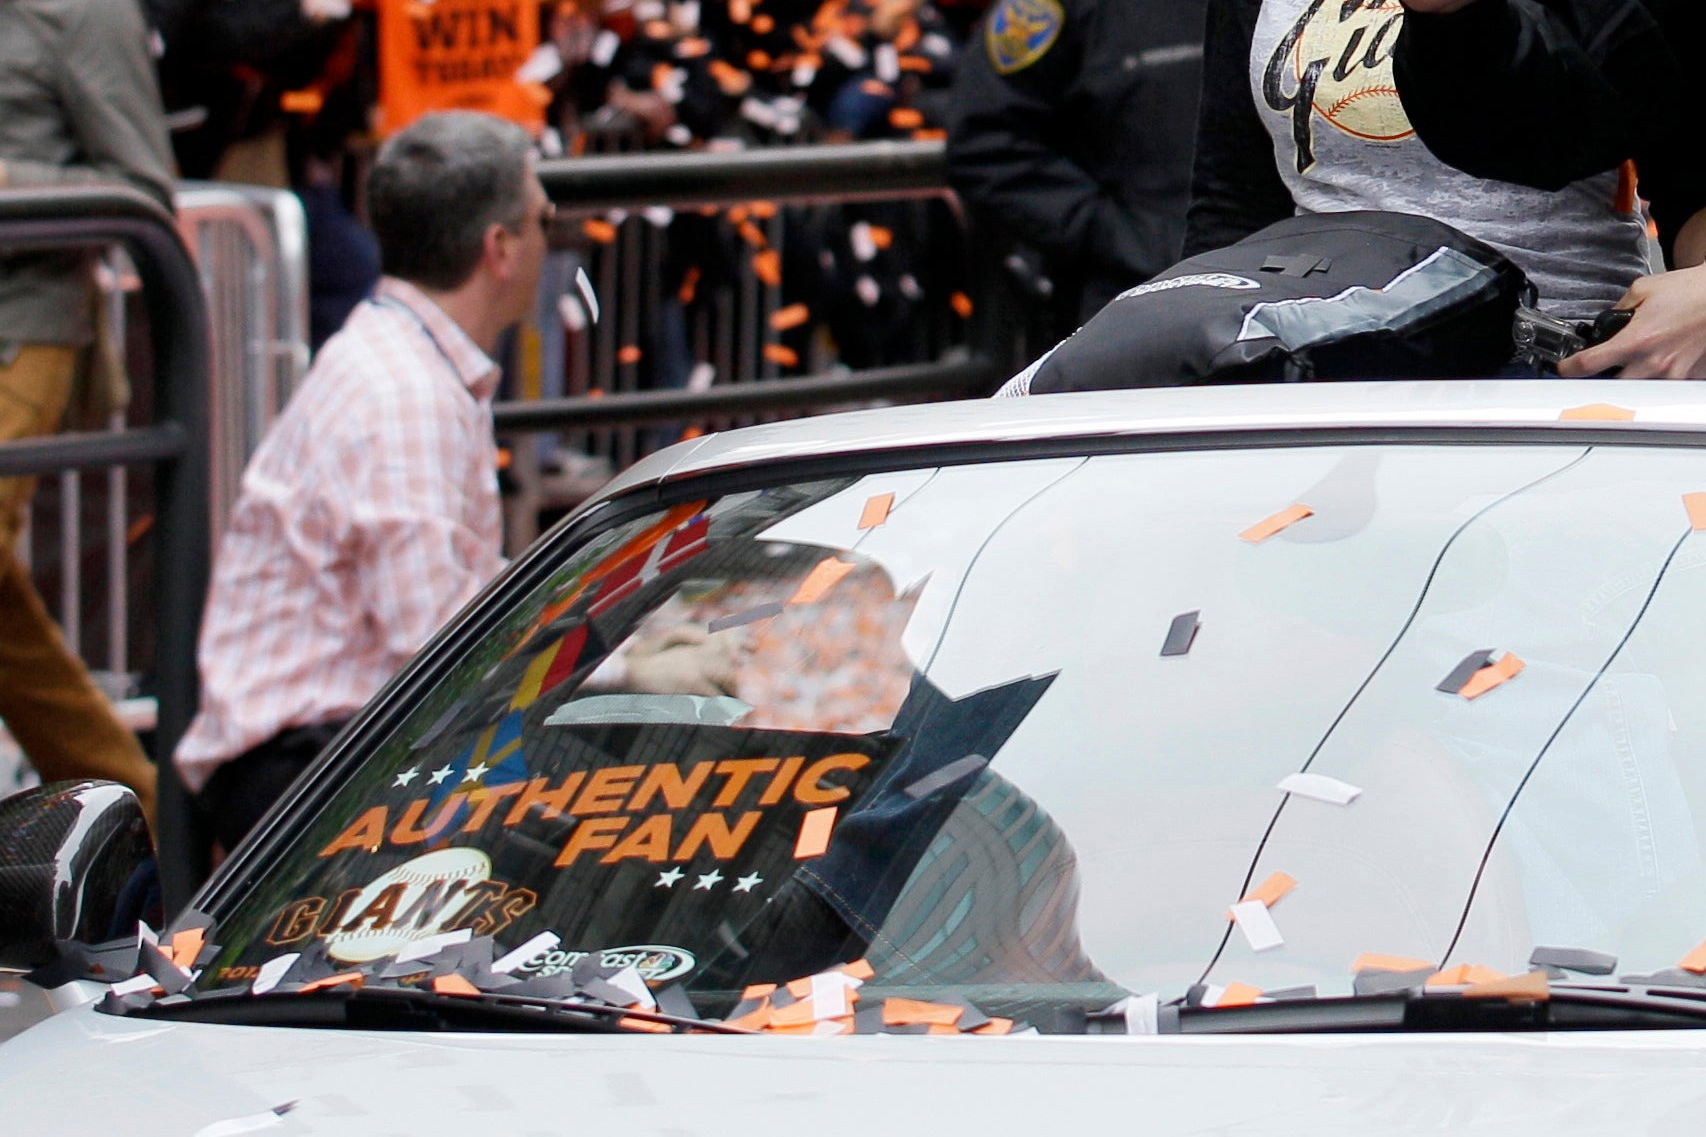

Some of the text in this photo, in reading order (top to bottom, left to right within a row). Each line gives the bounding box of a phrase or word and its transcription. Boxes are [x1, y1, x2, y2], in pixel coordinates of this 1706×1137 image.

[413, 6, 519, 50] WIN
[317, 753, 871, 858] AUTHENTIC
[554, 811, 763, 869] FAN
[265, 879, 537, 946] GIANTS
